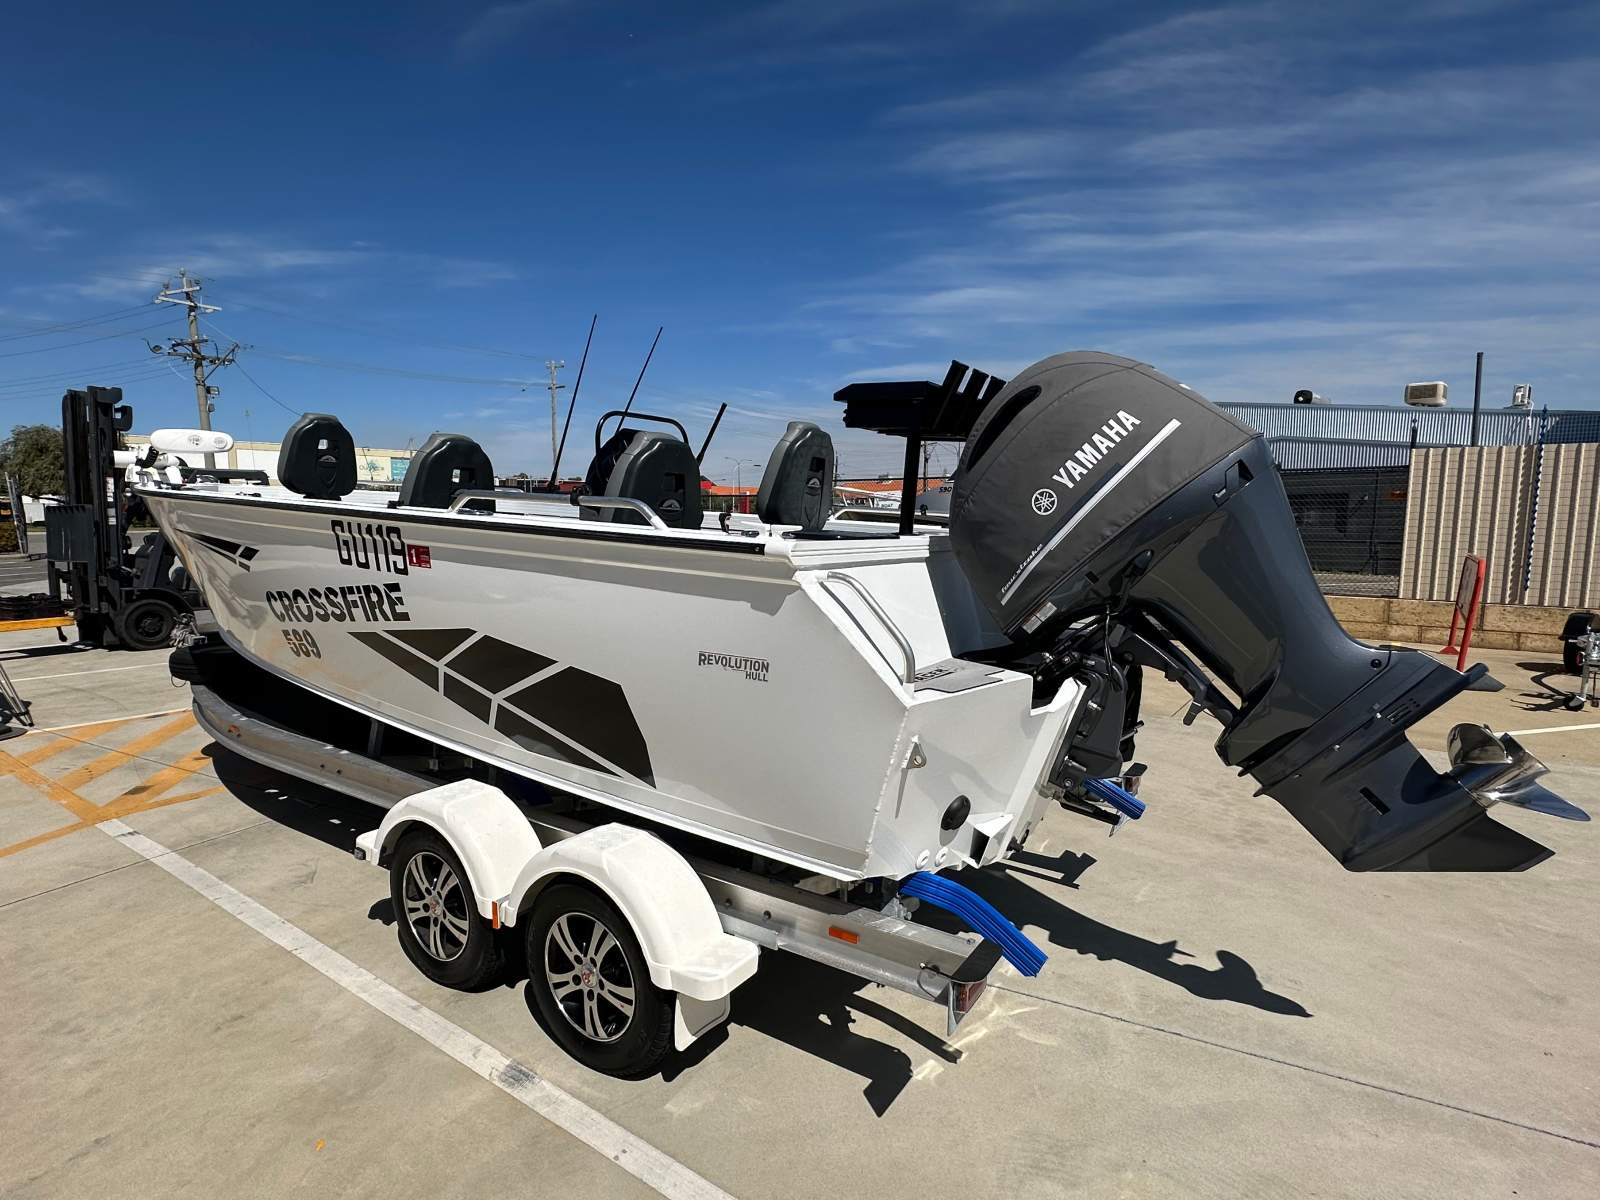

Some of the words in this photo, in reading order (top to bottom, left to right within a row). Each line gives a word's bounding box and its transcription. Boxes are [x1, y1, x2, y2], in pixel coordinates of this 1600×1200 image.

[1052, 410, 1141, 489] YAMAHA
[331, 520, 409, 576] GU119
[265, 582, 411, 623] CROSSFIRE
[282, 628, 322, 659] 589
[698, 652, 770, 673] REVOLUTION
[745, 671, 769, 682] HULL
